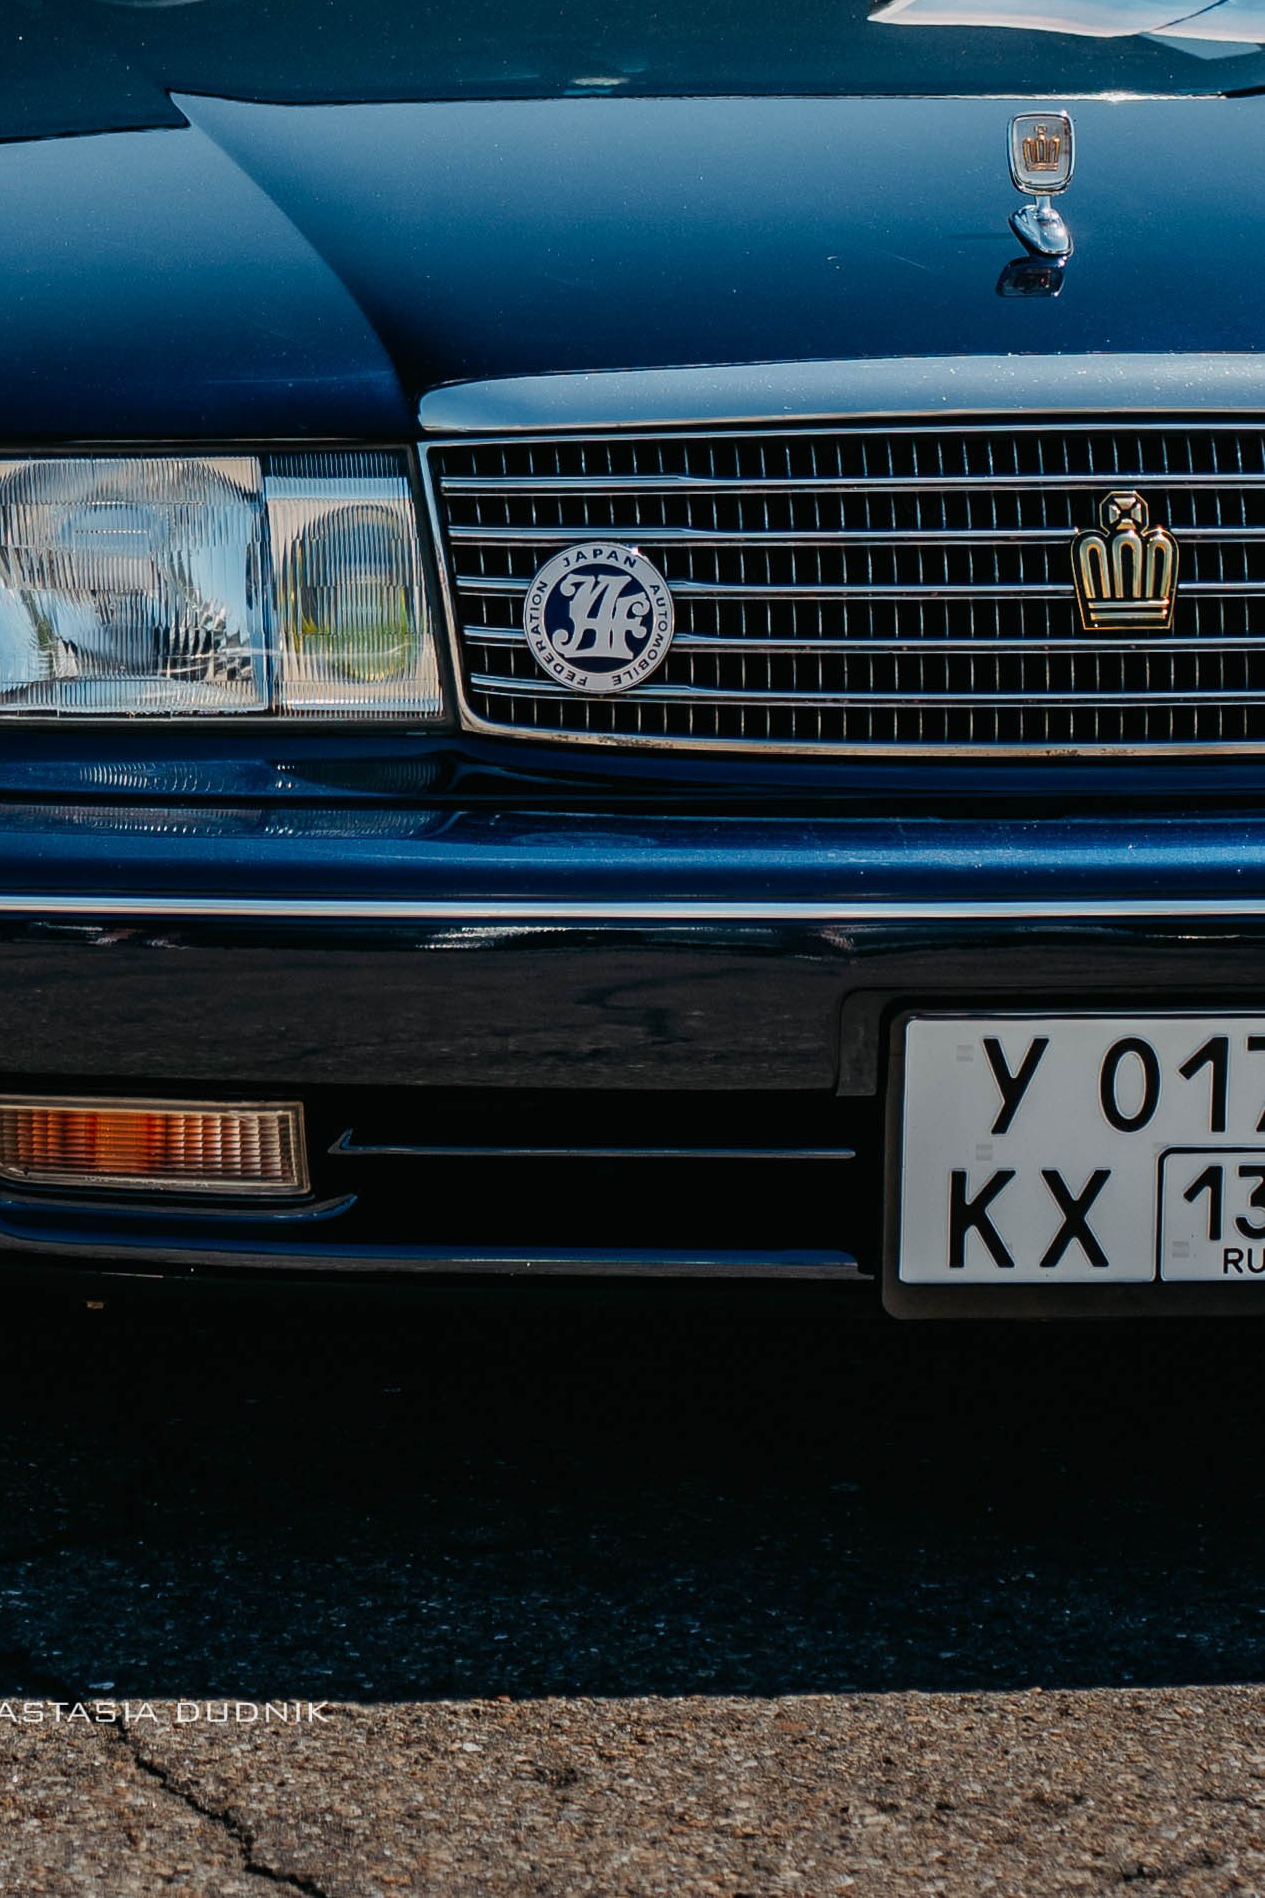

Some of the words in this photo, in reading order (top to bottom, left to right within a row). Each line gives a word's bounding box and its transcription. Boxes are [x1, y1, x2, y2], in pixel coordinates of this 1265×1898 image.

[562, 548, 637, 568] JAPAN
[529, 581, 588, 687] FEDERATION
[611, 584, 668, 686] AUTOMOBILE
